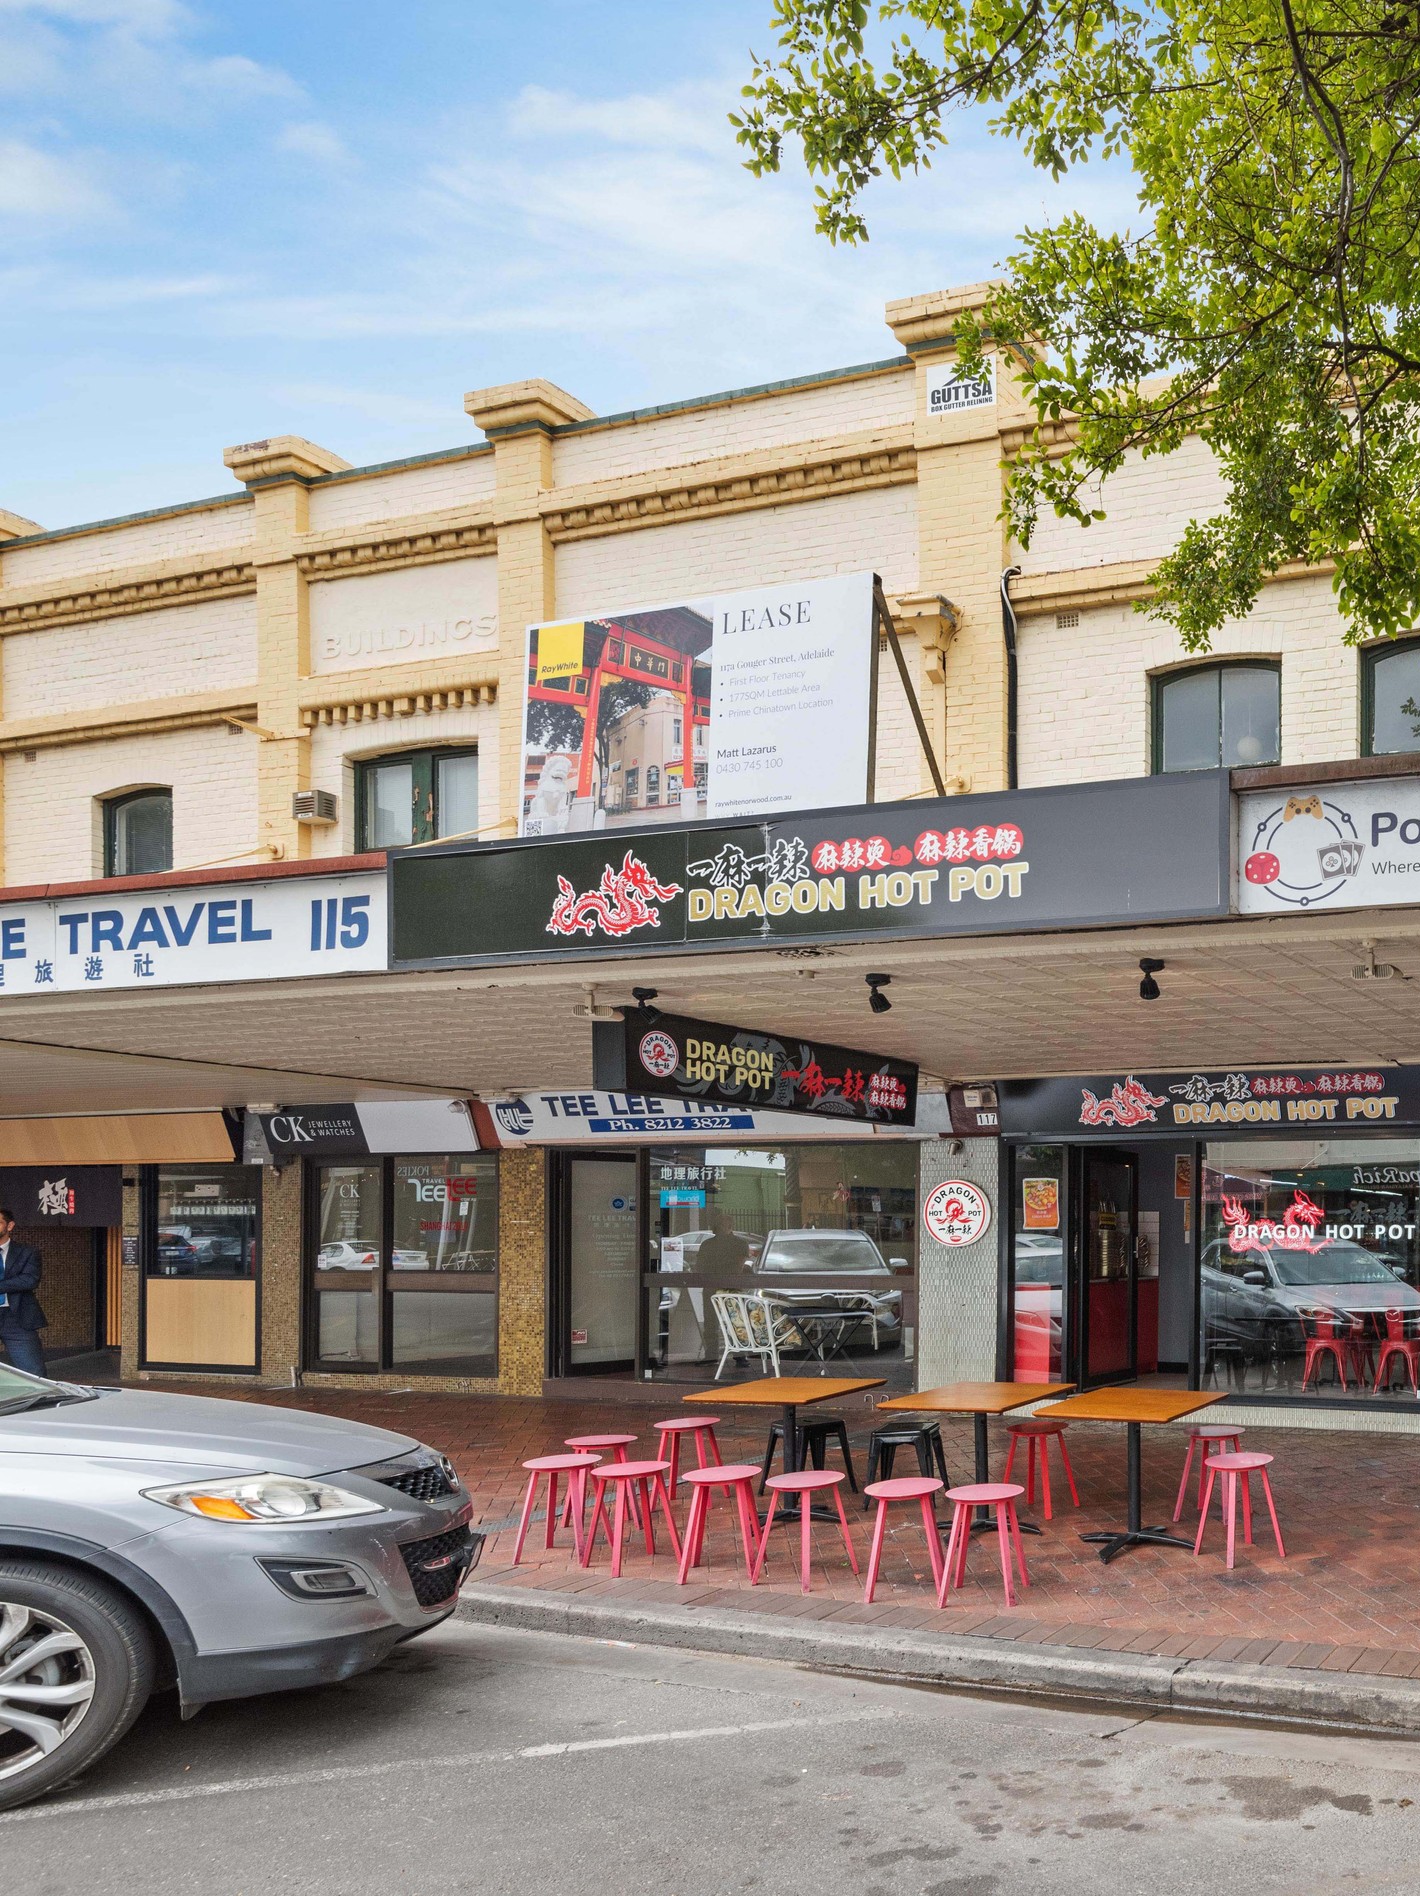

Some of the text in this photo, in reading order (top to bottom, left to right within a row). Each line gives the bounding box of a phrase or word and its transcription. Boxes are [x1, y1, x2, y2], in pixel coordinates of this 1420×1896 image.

[931, 380, 992, 405] GUTTSA
[944, 401, 966, 411] GUTTER
[967, 396, 993, 407] RELINING
[722, 600, 811, 635] LEASE
[737, 656, 768, 669] Gouger
[769, 653, 797, 665] Street,
[797, 648, 835, 661] Adelaide
[729, 670, 806, 687] First Floor Tenancy
[729, 683, 820, 703] 177SQM Lettable Area
[728, 697, 834, 719] Prime Chinatown Location
[716, 748, 739, 759] Matt
[741, 745, 777, 757] Lazarus
[716, 757, 784, 775] 0430 745 100
[1371, 858, 1420, 875] Where
[688, 861, 1029, 923] DRAGON HOT POT
[58, 899, 272, 955] TRAVEL
[310, 895, 371, 952] 115
[686, 1038, 774, 1072] DRAGON
[686, 1059, 774, 1090] HOT POT
[541, 1095, 599, 1117] TEE
[608, 1094, 665, 1115] LEE
[1173, 1096, 1399, 1124] DRAGON HOT POT
[308, 1120, 352, 1128] JEWELLERY
[608, 1117, 732, 1131] Ph. 8212 3822
[979, 1114, 996, 1125] 117
[270, 1116, 314, 1143] CK
[317, 1128, 355, 1136] WATCHES
[660, 1167, 726, 1181] 地理旅行社
[340, 1184, 361, 1198] CK
[934, 1187, 977, 1204] DRAGON
[1233, 1224, 1416, 1240] DRAGON HOT POT
